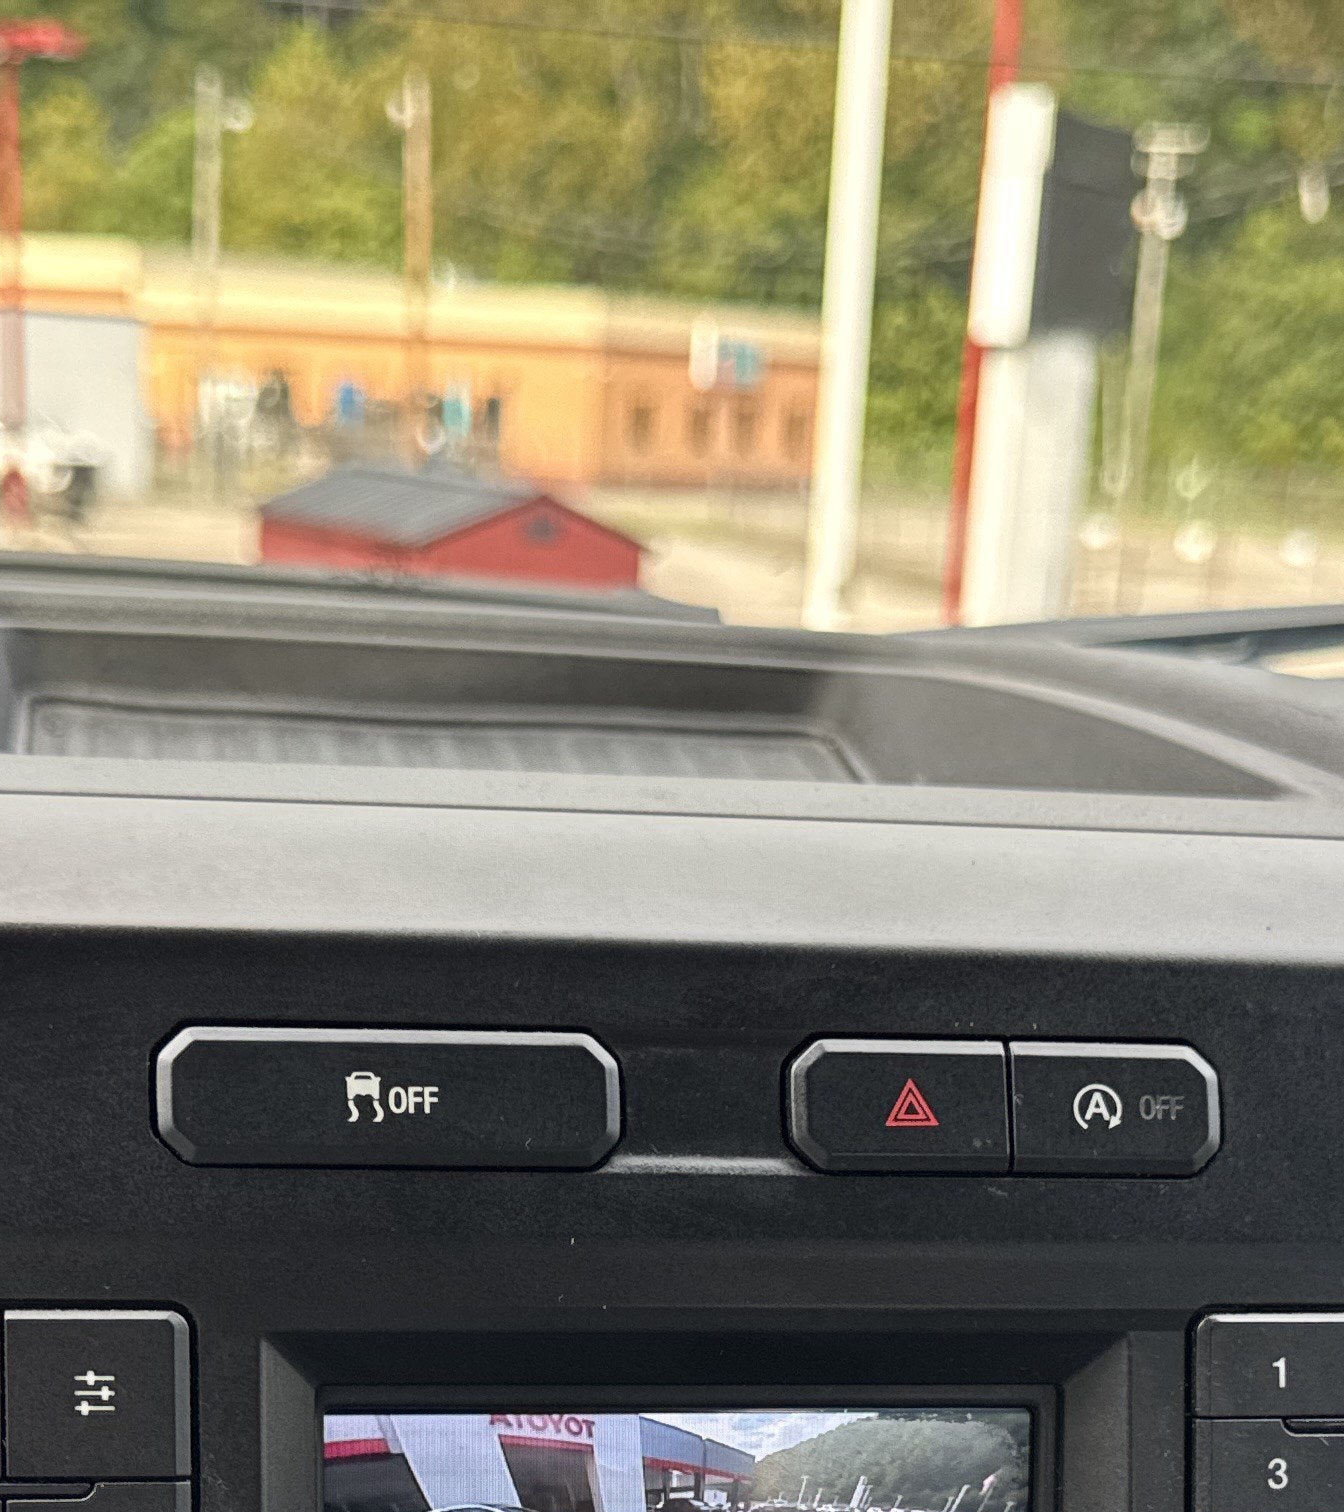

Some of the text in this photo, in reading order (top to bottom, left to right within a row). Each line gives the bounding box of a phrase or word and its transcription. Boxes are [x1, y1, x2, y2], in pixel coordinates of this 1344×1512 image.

[388, 1086, 439, 1114] OFF
[1139, 1095, 1185, 1121] OFF
[1272, 1357, 1286, 1388] 1
[1267, 1457, 1289, 1490] 3
